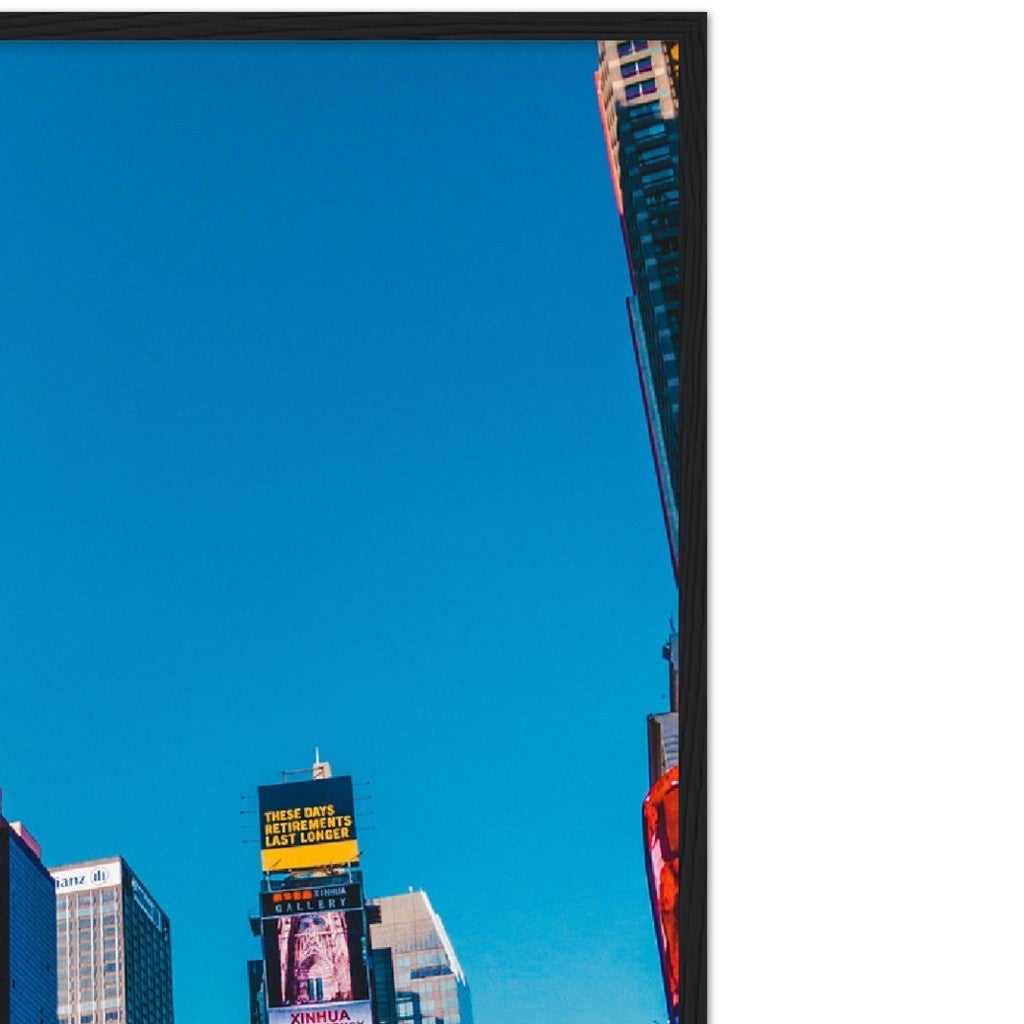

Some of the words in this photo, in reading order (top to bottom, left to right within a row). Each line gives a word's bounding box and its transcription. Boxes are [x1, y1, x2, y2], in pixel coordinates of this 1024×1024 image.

[264, 808, 301, 822] THESE
[304, 804, 335, 818] DAYS
[265, 815, 352, 835] RETIREMENTS
[265, 833, 296, 847] LAST
[300, 827, 350, 843] LONGER
[313, 887, 346, 898] XINHUA
[275, 898, 346, 913] GALLERY
